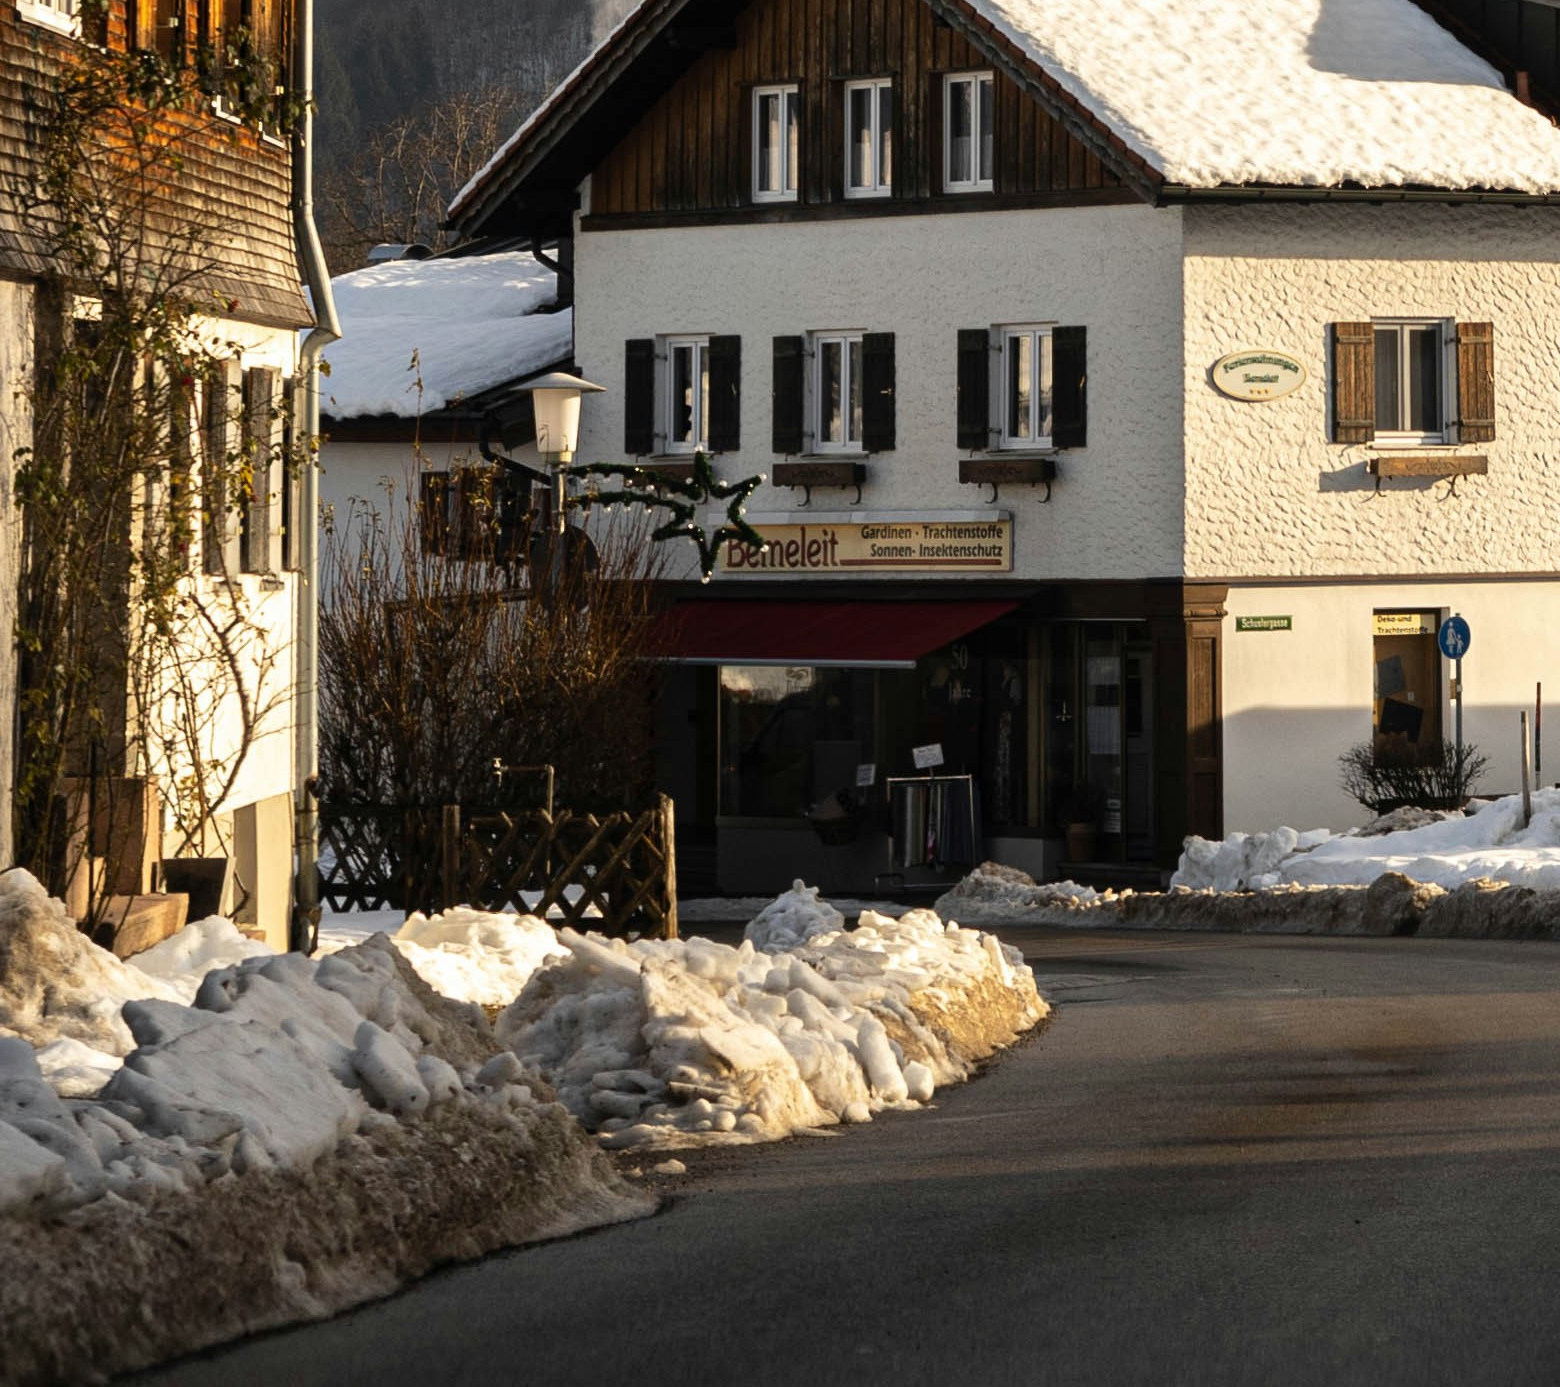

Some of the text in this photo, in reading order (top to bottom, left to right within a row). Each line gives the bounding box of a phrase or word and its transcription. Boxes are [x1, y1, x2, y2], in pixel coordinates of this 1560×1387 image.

[861, 525, 1003, 539] Gardinen Trachtenstoffe
[919, 543, 1003, 557] Insektenschutz
